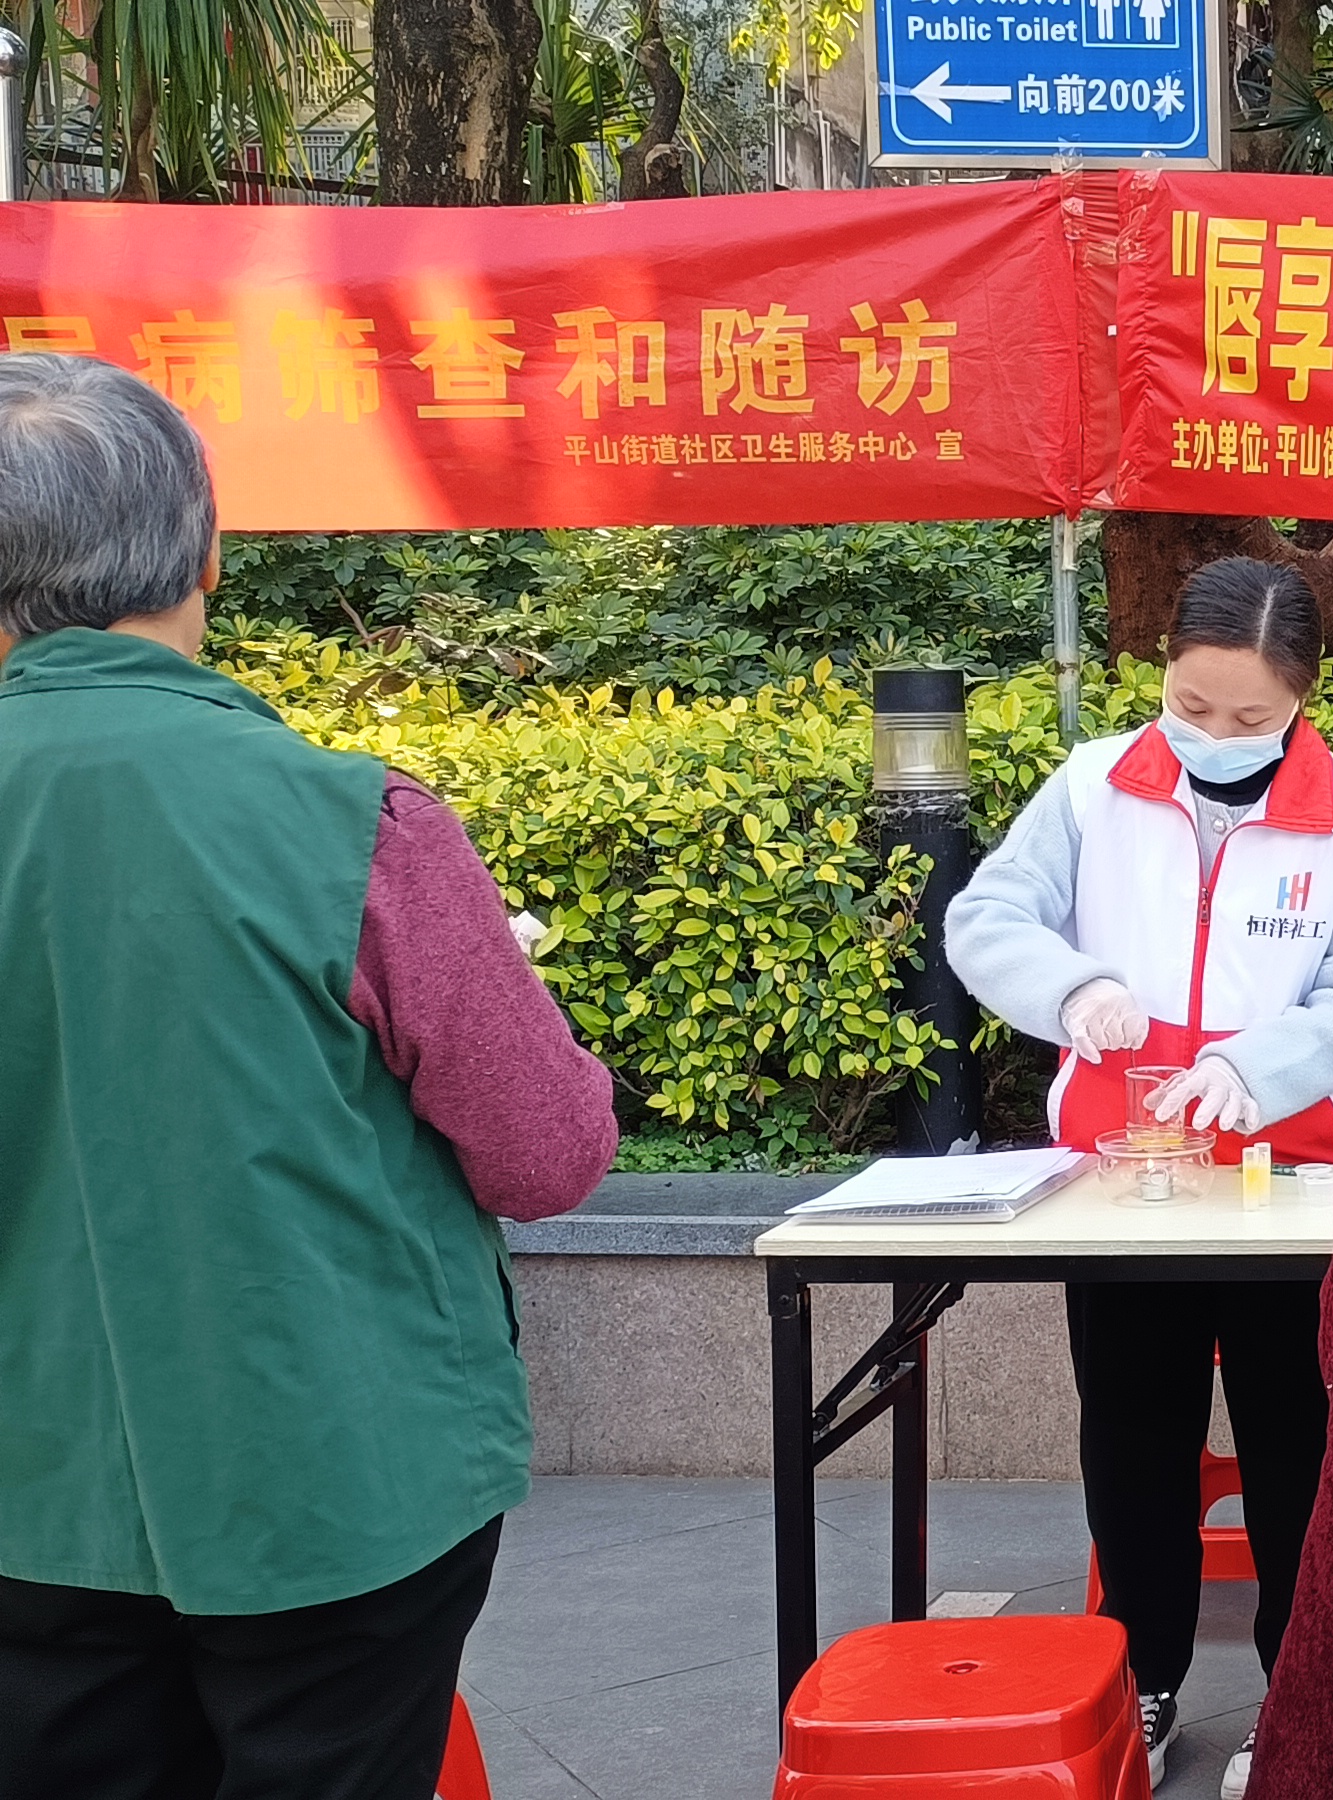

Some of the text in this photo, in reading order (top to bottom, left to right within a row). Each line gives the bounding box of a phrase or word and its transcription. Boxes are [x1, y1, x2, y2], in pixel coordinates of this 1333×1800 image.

[907, 16, 1078, 42] Public Toilet
[1017, 73, 1186, 116] 向前200米
[563, 430, 965, 466] 平山街道社区卫生服务中心 宣
[1247, 915, 1327, 939] 恒洋社工
